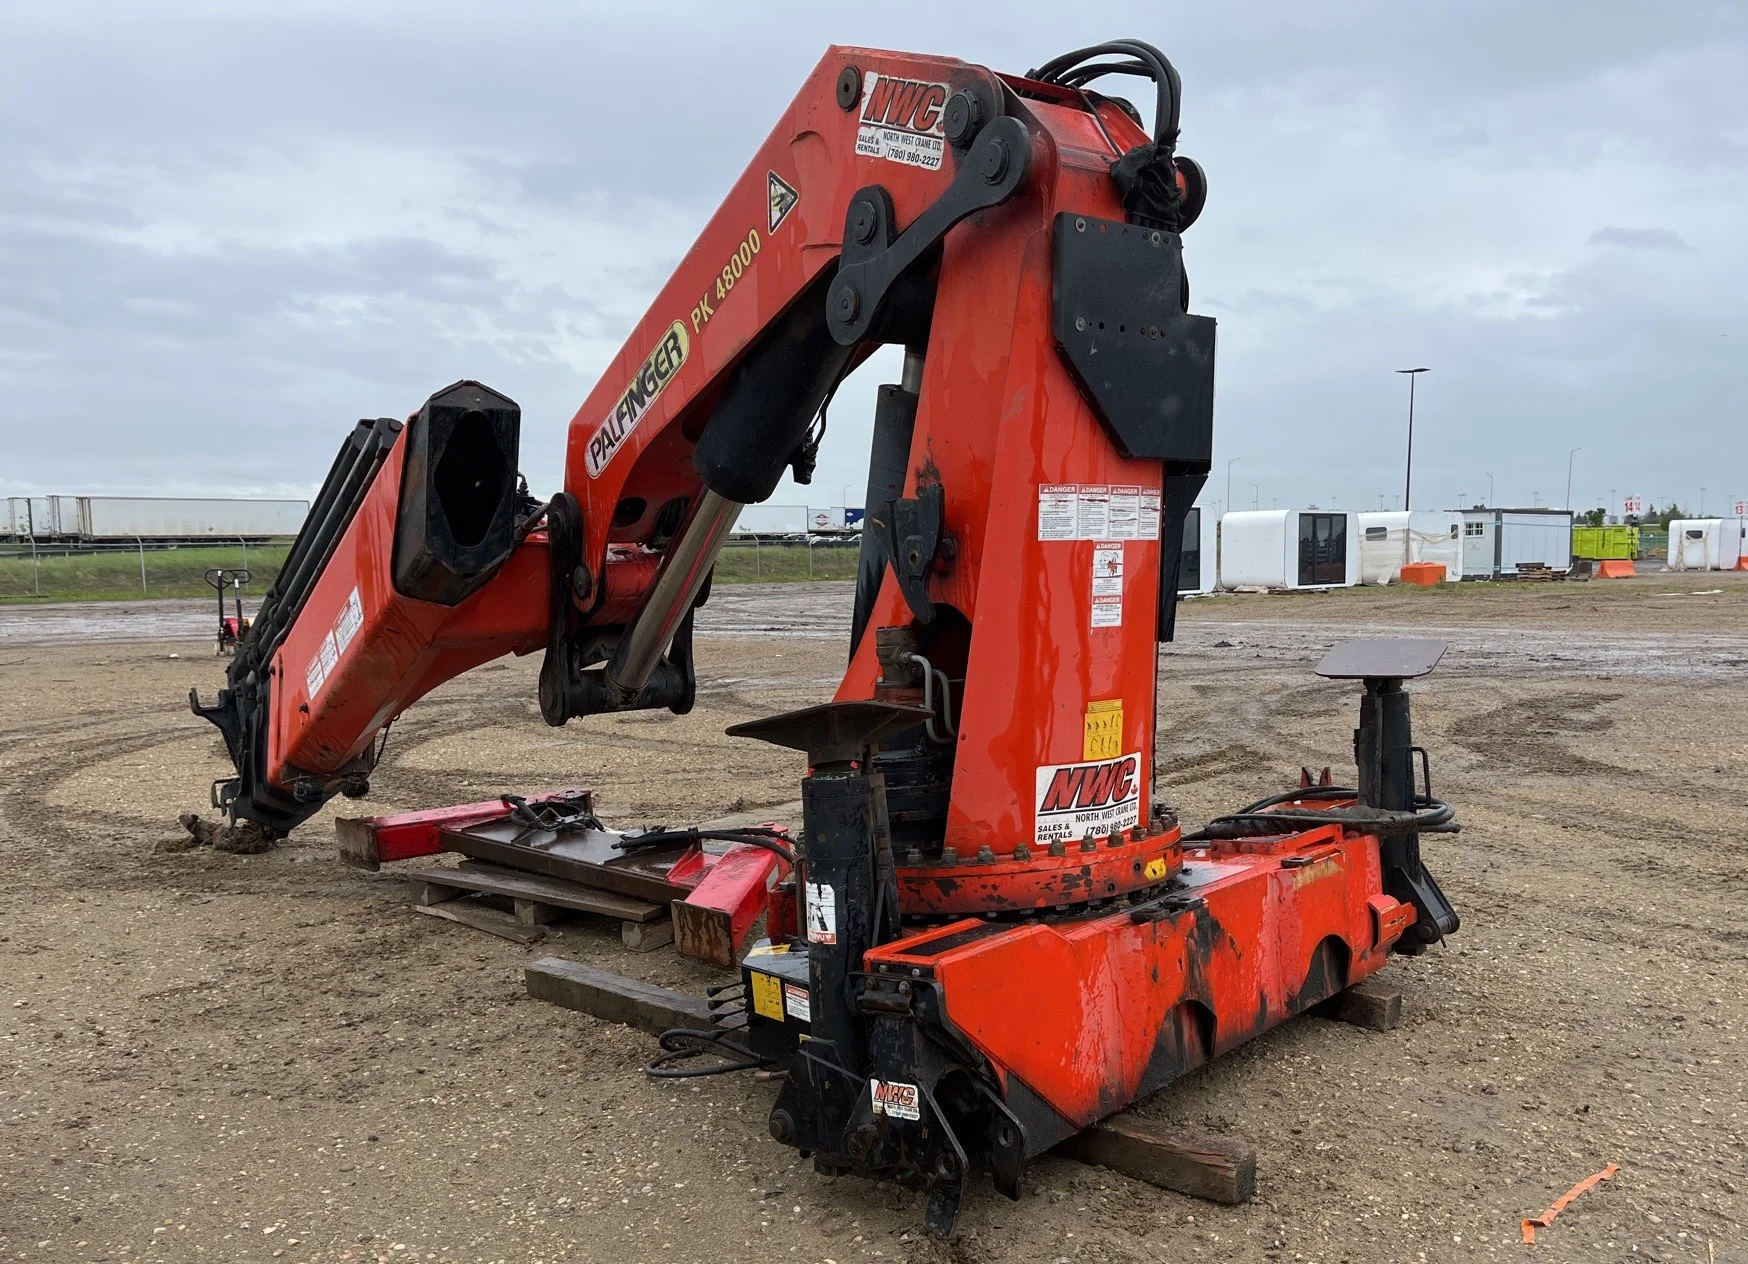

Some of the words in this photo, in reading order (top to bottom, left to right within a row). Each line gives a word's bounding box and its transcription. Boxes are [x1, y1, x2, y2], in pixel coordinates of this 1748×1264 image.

[862, 77, 946, 131] NWC
[857, 143, 880, 155] RENTALS
[858, 134, 874, 145] SALES
[882, 131, 900, 143] NORTH
[900, 134, 915, 145] WEST
[915, 136, 931, 149] CRANE
[887, 147, 906, 161] (780)
[906, 152, 940, 167] 980-2227
[690, 292, 715, 334] PK
[715, 229, 761, 299] 48000
[589, 332, 683, 470] PALFINGER
[1624, 502, 1633, 513] 14
[1735, 505, 1743, 515] 13
[1099, 596, 1120, 604] DANGER
[1039, 757, 1136, 812] NWC
[1075, 812, 1099, 823] NORTH
[1101, 808, 1116, 820] WEST
[1115, 805, 1129, 816] CRANE
[1129, 801, 1138, 813] LTD.
[1037, 824, 1063, 833] SALES
[1064, 822, 1070, 830] &
[1085, 824, 1109, 837] (780)
[1109, 815, 1137, 831] 980-2227
[1037, 831, 1073, 842] RENTALS
[874, 1083, 915, 1106] NWC
